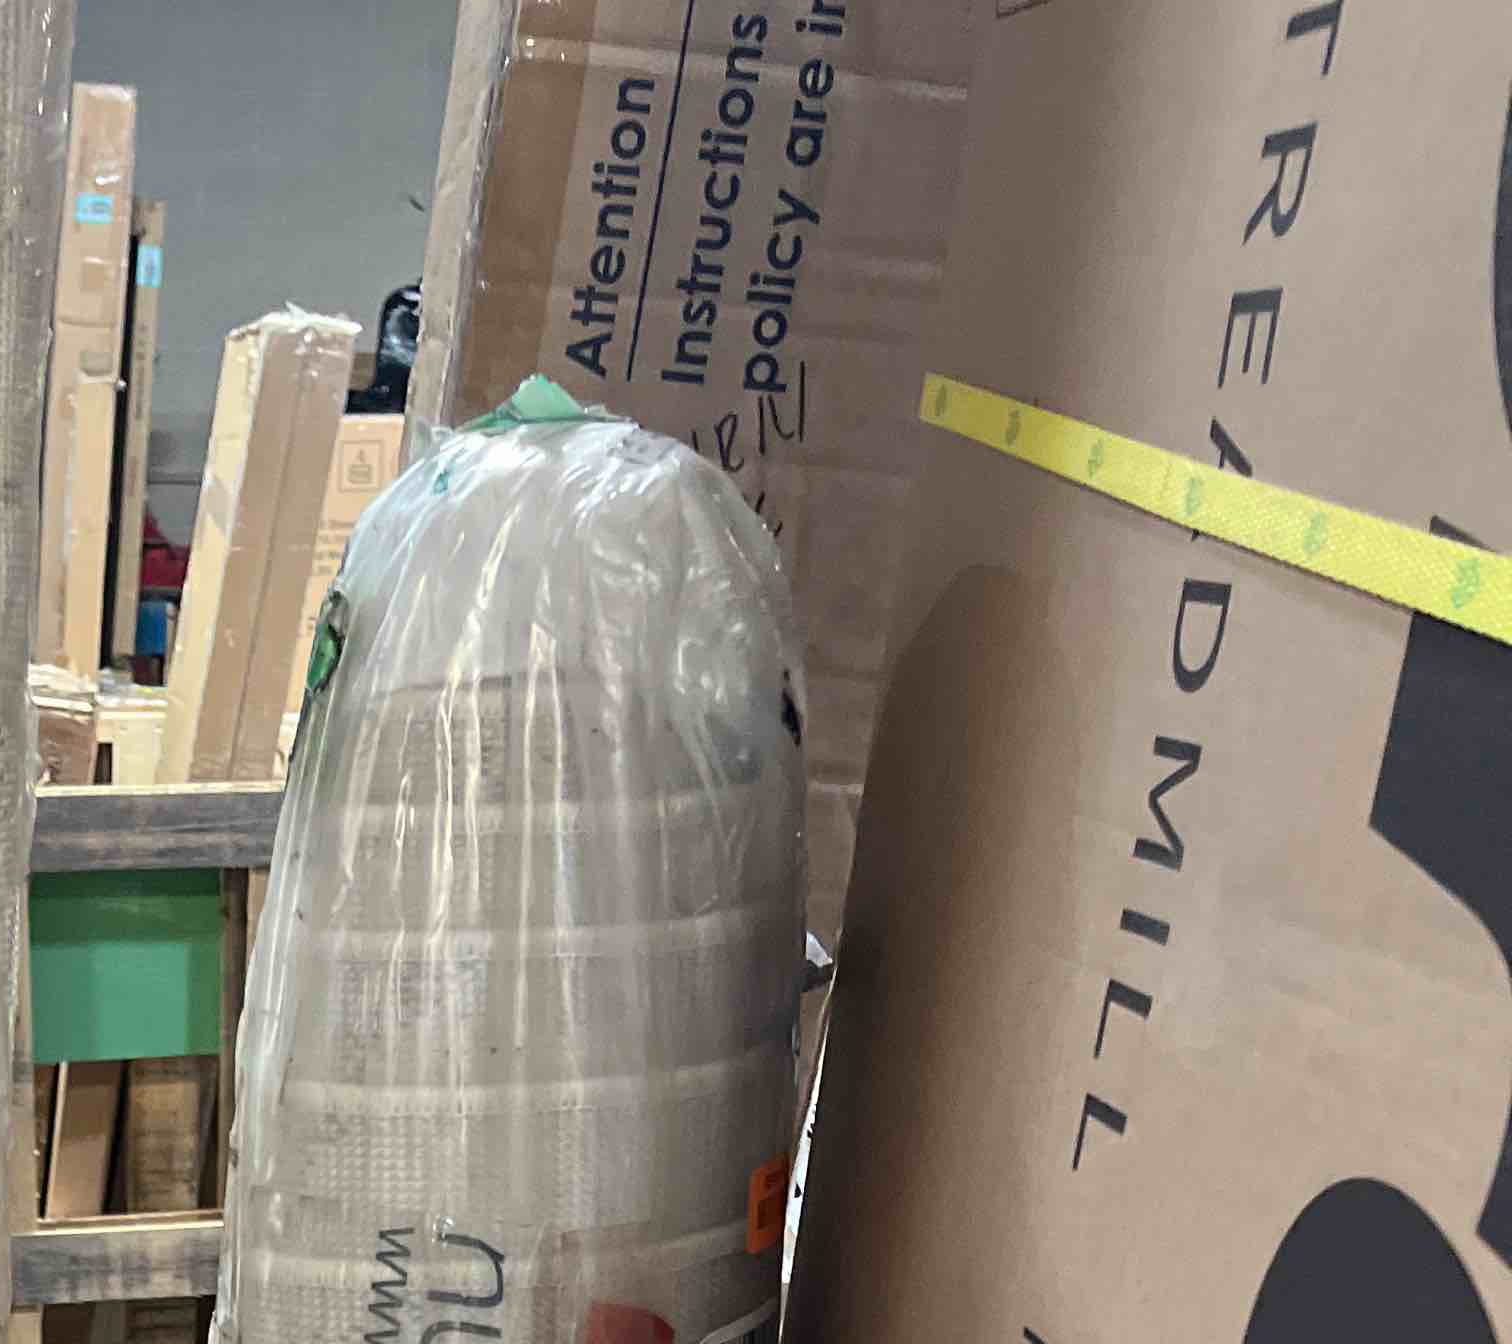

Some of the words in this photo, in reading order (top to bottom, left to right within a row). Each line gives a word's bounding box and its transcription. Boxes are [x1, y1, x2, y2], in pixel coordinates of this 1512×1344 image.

[565, 76, 655, 379] Attention
[661, 12, 767, 386] Instructions
[744, 189, 819, 392] policy
[787, 58, 836, 168] are
